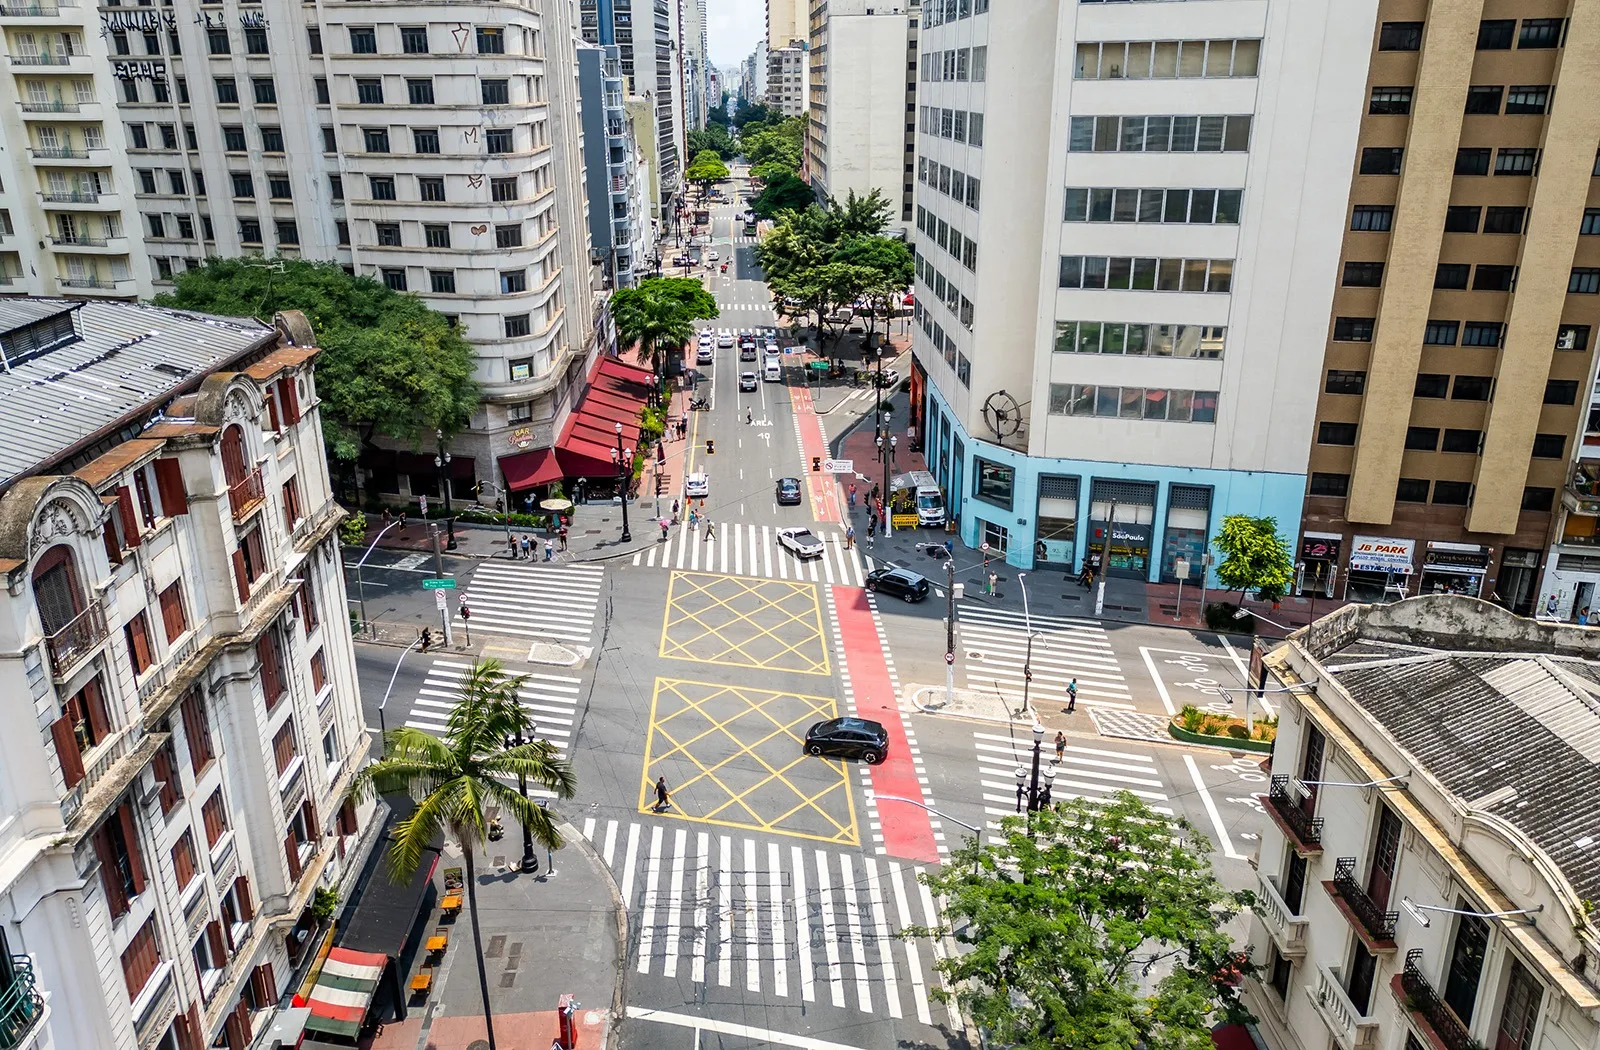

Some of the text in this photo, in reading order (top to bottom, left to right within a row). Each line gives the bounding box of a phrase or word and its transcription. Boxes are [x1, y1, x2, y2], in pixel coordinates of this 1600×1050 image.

[514, 428, 530, 436] BAR
[1357, 543, 1408, 554] JB PARK
